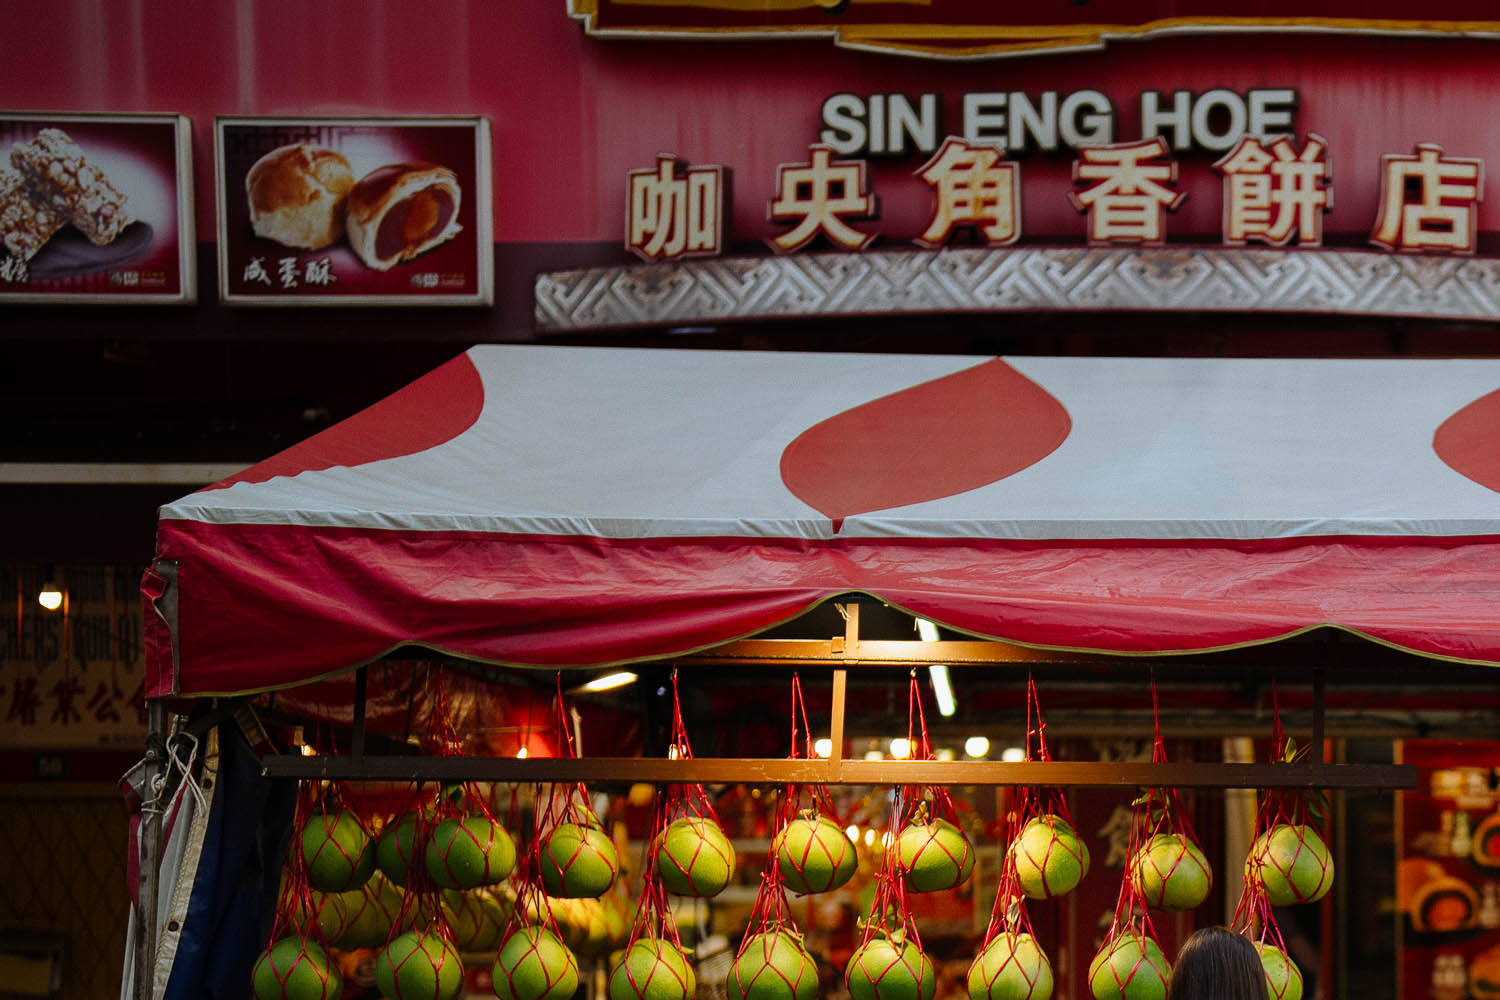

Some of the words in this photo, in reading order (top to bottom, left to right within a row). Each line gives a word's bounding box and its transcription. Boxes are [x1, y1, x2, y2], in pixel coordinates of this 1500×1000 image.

[820, 93, 937, 152] SIN
[963, 90, 1113, 151] ENG
[1142, 90, 1297, 152] HOE
[626, 132, 1485, 258] 咖央角香餅店
